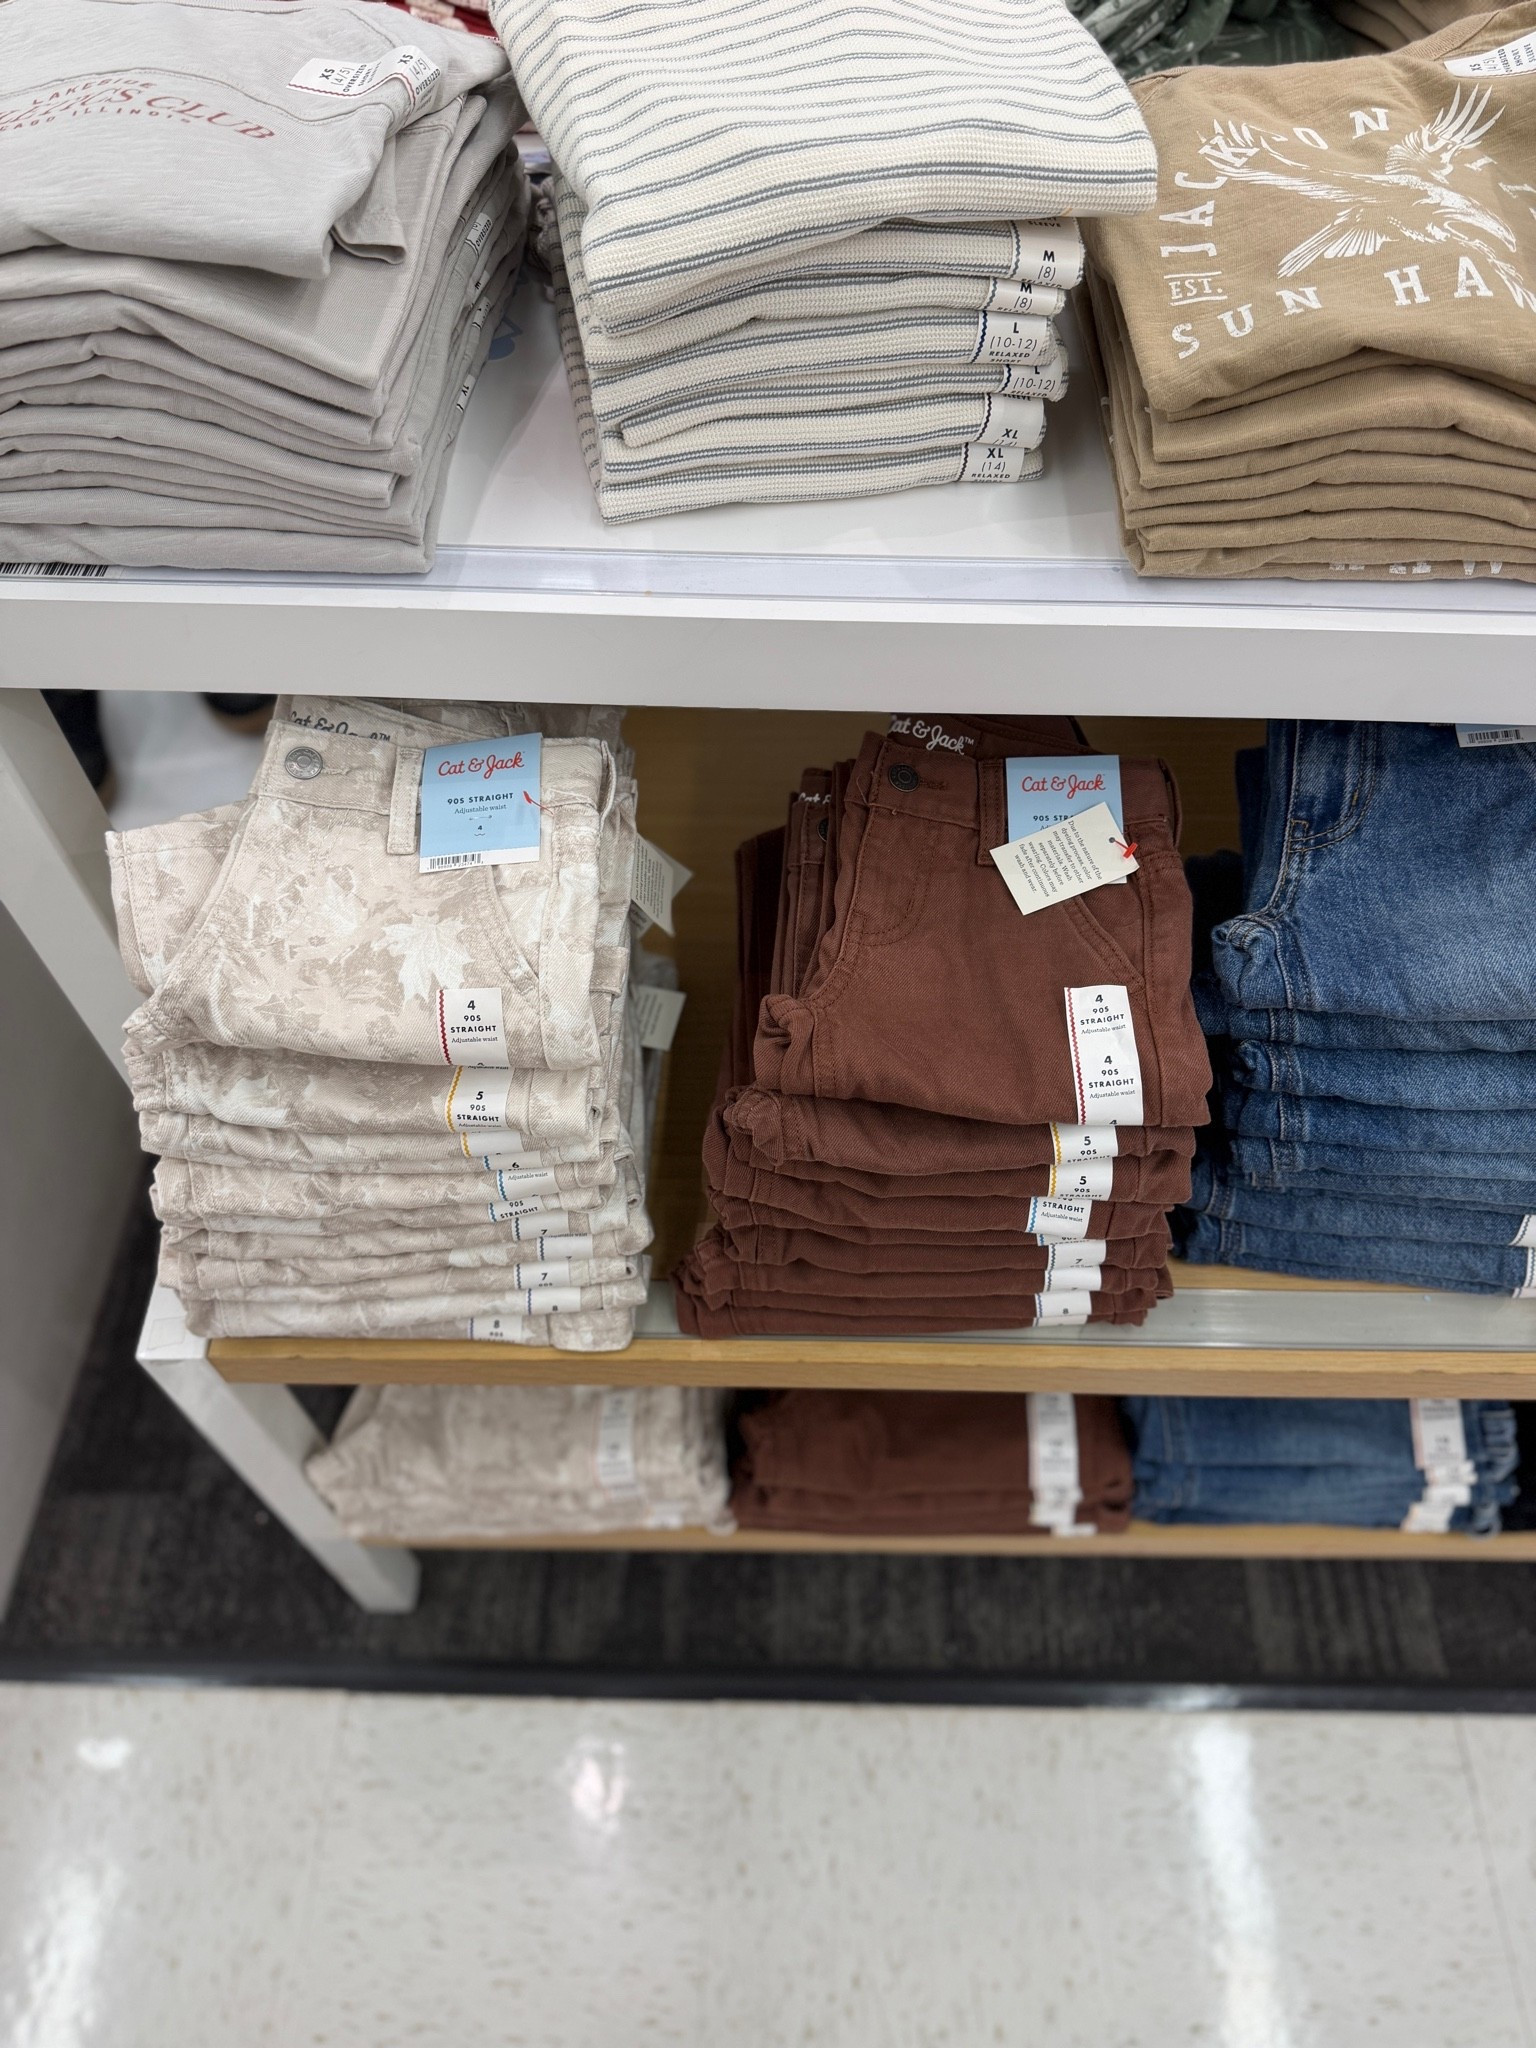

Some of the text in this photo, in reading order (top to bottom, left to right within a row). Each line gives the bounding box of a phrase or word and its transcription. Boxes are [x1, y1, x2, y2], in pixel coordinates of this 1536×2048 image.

[397, 53, 414, 64] XS
[319, 68, 335, 80] XS
[343, 64, 367, 93] OVERSIZED
[415, 68, 441, 95] OVERSIZED
[32, 78, 157, 105] LAKESIDE
[146, 96, 275, 139] CLUB
[1043, 250, 1055, 262] M
[1038, 265, 1056, 281] (8)
[1020, 282, 1032, 294] M
[1169, 278, 1223, 299] EST.
[1013, 322, 1019, 333] L
[1171, 286, 1323, 360] SUN
[990, 336, 1037, 351] (10-12)
[1035, 366, 1040, 374] L
[1013, 377, 1056, 392] (10-12)
[1002, 428, 1018, 439] XL
[986, 448, 1004, 458] XL
[982, 461, 1006, 472] (14)
[438, 751, 525, 779] Cat & Jack
[1022, 774, 1106, 799] Cat & Jack
[447, 792, 514, 805] 90S STRAIGHT
[454, 803, 507, 814] Adjustable waist
[1095, 994, 1103, 1003] 4
[467, 1000, 476, 1010] 4
[1092, 1006, 1109, 1014] 90S
[1080, 1014, 1125, 1025] STRAIGHT
[450, 1025, 497, 1033] STRAIGHT
[1104, 1056, 1112, 1064] 4
[1088, 1078, 1135, 1088] STRAIGHT
[476, 1091, 484, 1100] 5
[1089, 1091, 1119, 1099] Adjustable
[457, 1114, 499, 1122] STRAIGHT
[1084, 1136, 1091, 1145] 5
[508, 1172, 534, 1181] Adjustable
[1079, 1176, 1087, 1185] 5
[509, 1200, 524, 1208] 90S
[1042, 1201, 1085, 1213] STRAIGHT
[500, 1207, 538, 1219] STRAIGHT
[1041, 1211, 1068, 1220] Adjustable
